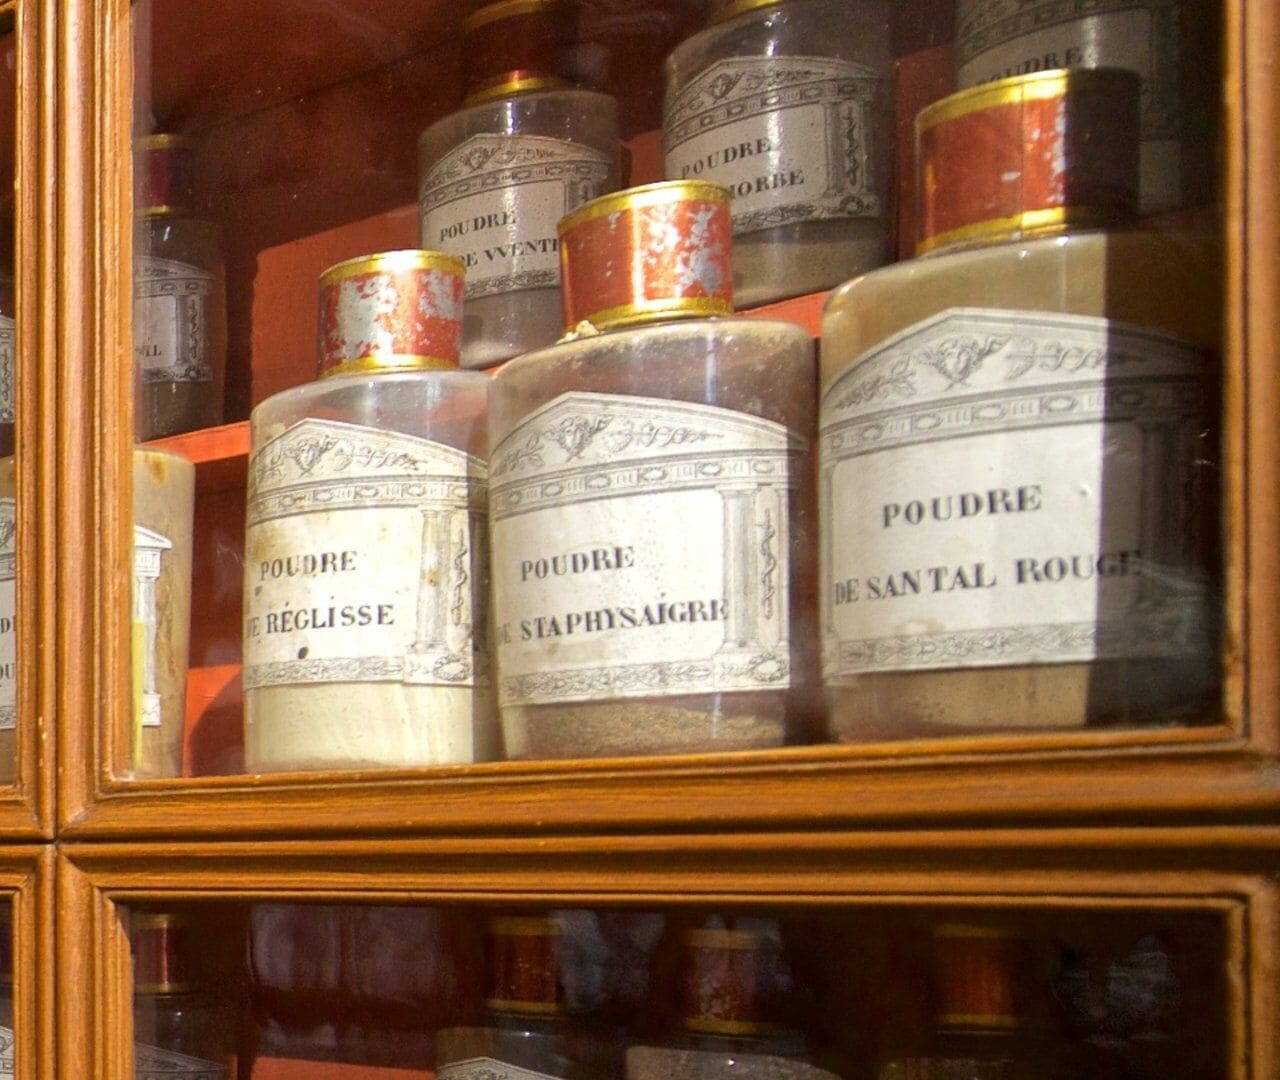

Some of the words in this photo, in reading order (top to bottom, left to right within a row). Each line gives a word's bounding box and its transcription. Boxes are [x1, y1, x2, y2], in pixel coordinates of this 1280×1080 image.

[681, 136, 772, 178] POUDRE
[440, 211, 517, 242] POUDRE
[883, 484, 1043, 529] POUDRE
[260, 549, 358, 581] POUDRE
[521, 544, 636, 582] POUDRE
[835, 578, 860, 607] DE
[867, 562, 997, 603] SANTAL
[266, 598, 395, 634] RÉGLISSE
[521, 595, 730, 642] STAPHYSAIGRE
